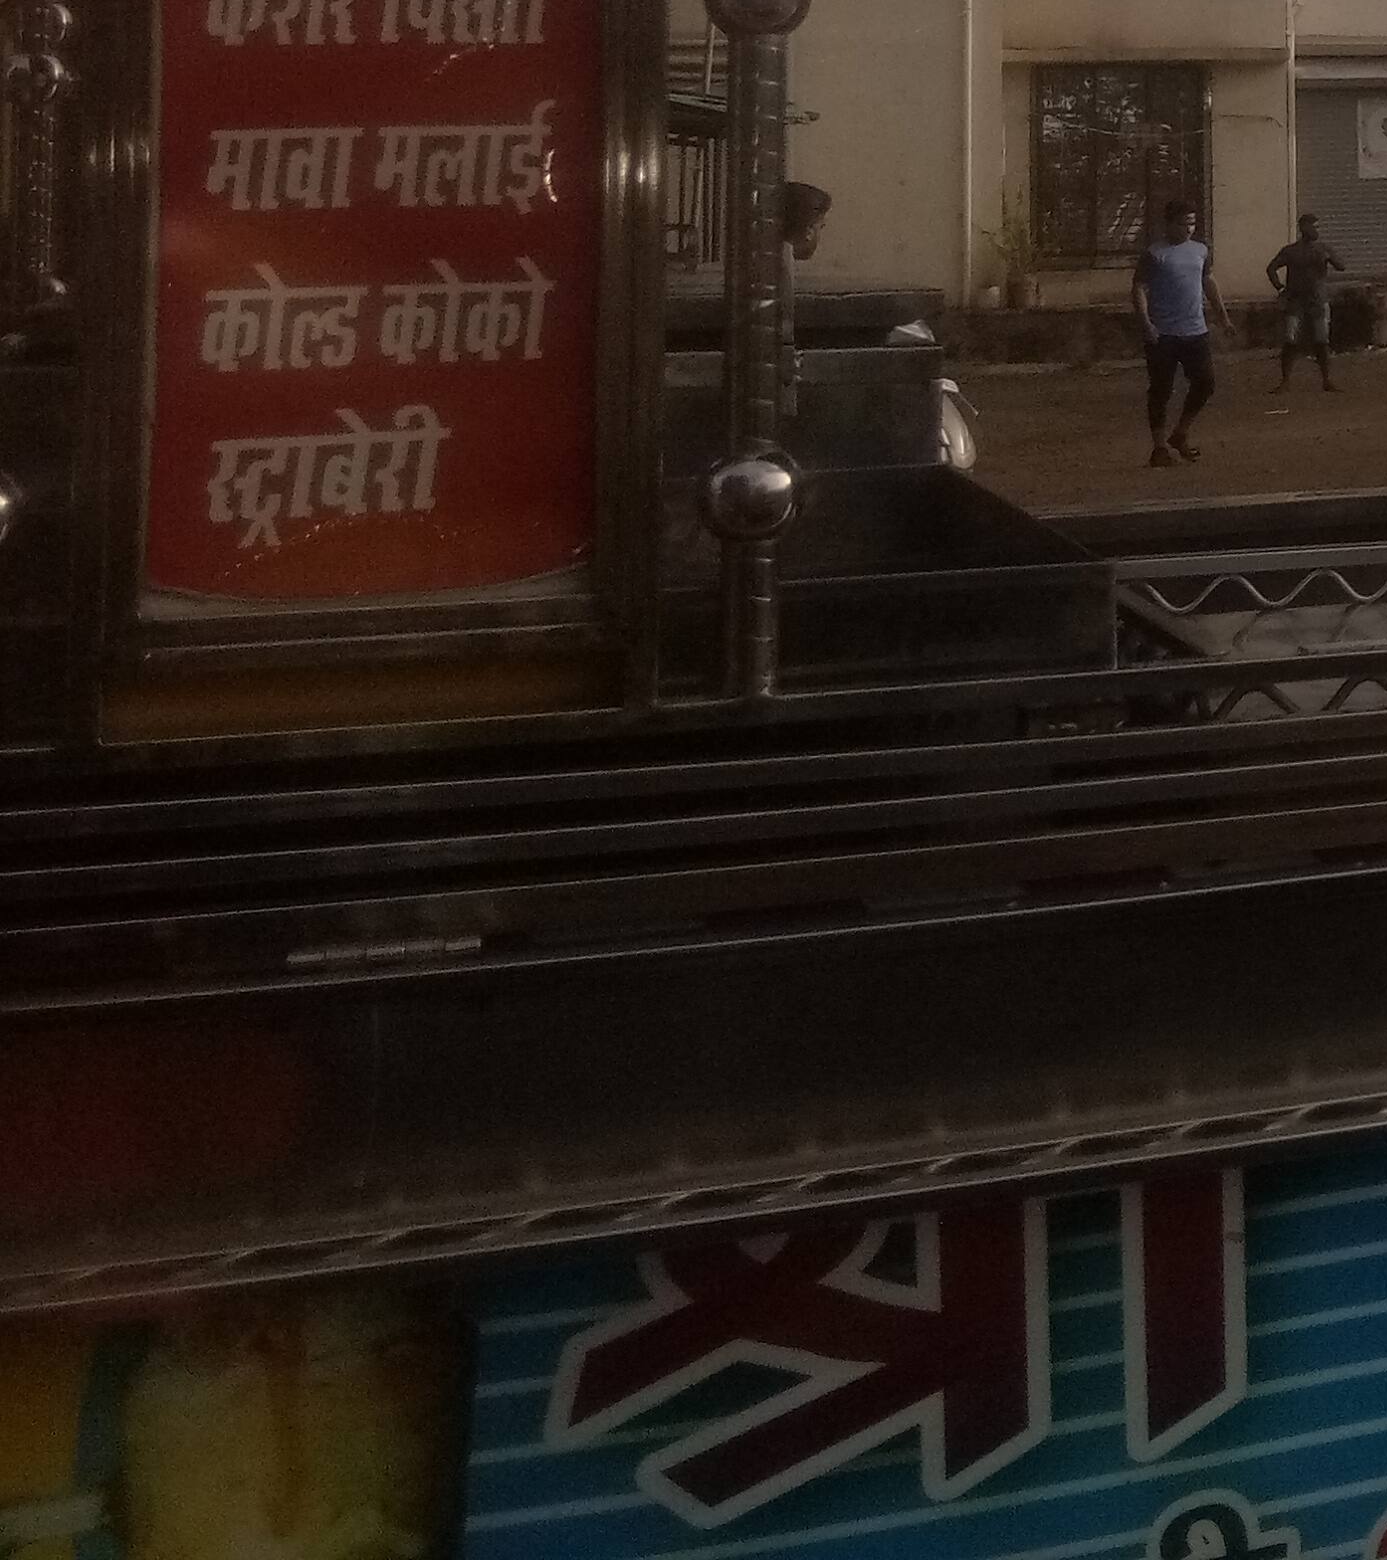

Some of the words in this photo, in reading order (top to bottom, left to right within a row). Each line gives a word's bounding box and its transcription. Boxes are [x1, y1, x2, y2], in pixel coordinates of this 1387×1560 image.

[207, 127, 364, 210] मावा
[374, 99, 556, 214] मलाई
[203, 261, 368, 372] कोल्ड
[379, 256, 556, 364] कोको
[207, 404, 452, 548] स्ट्राबेरी
